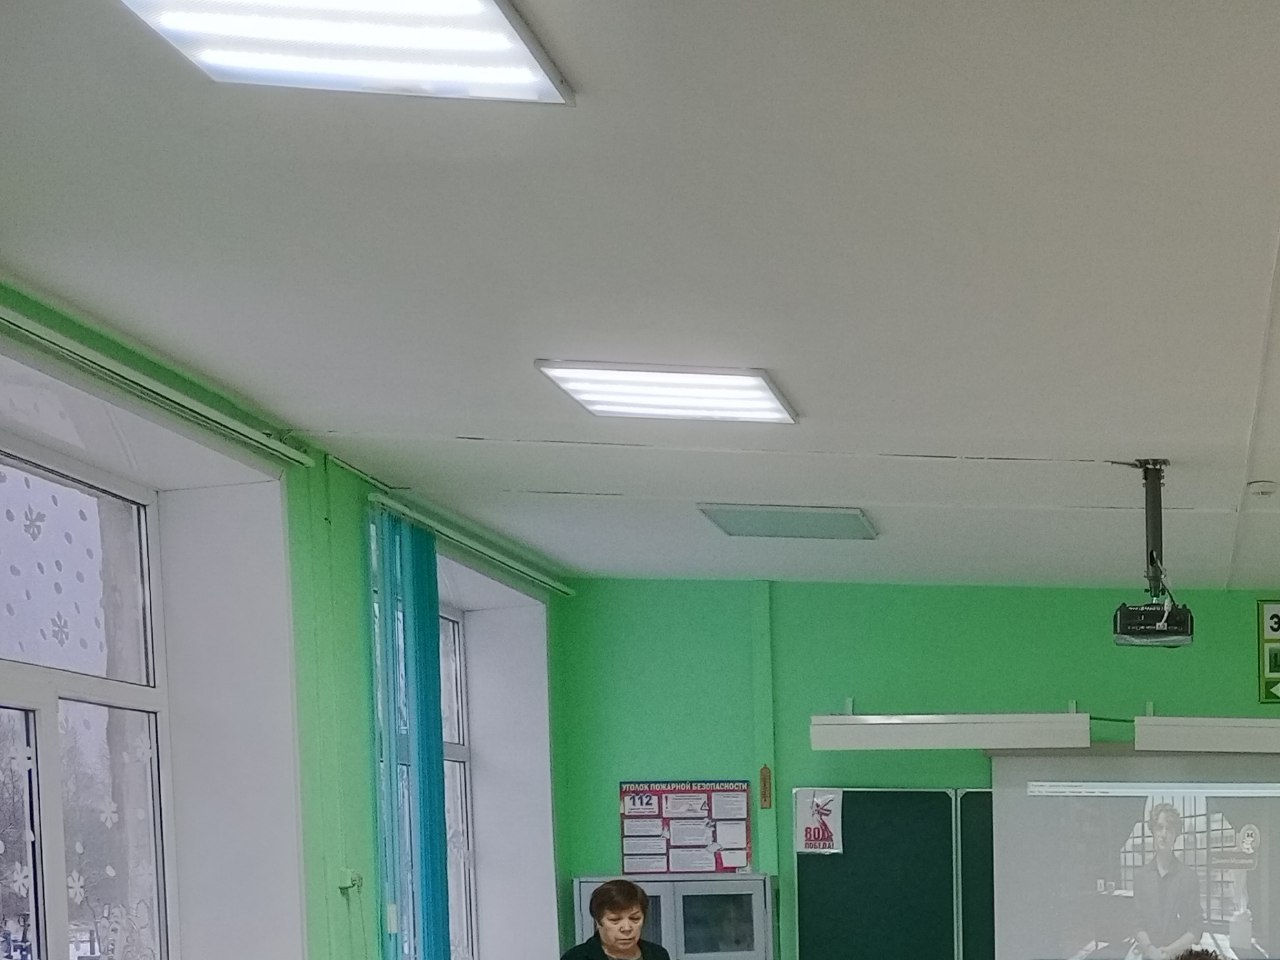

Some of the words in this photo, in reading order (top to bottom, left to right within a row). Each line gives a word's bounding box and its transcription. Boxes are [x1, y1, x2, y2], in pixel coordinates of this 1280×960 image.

[622, 784, 649, 792] УГОЛОК
[650, 781, 691, 791] ПОЖАРНОЙ
[692, 782, 748, 791] БЕЗОПАСНОСТИ
[630, 794, 653, 807] 112
[804, 827, 820, 840] 80
